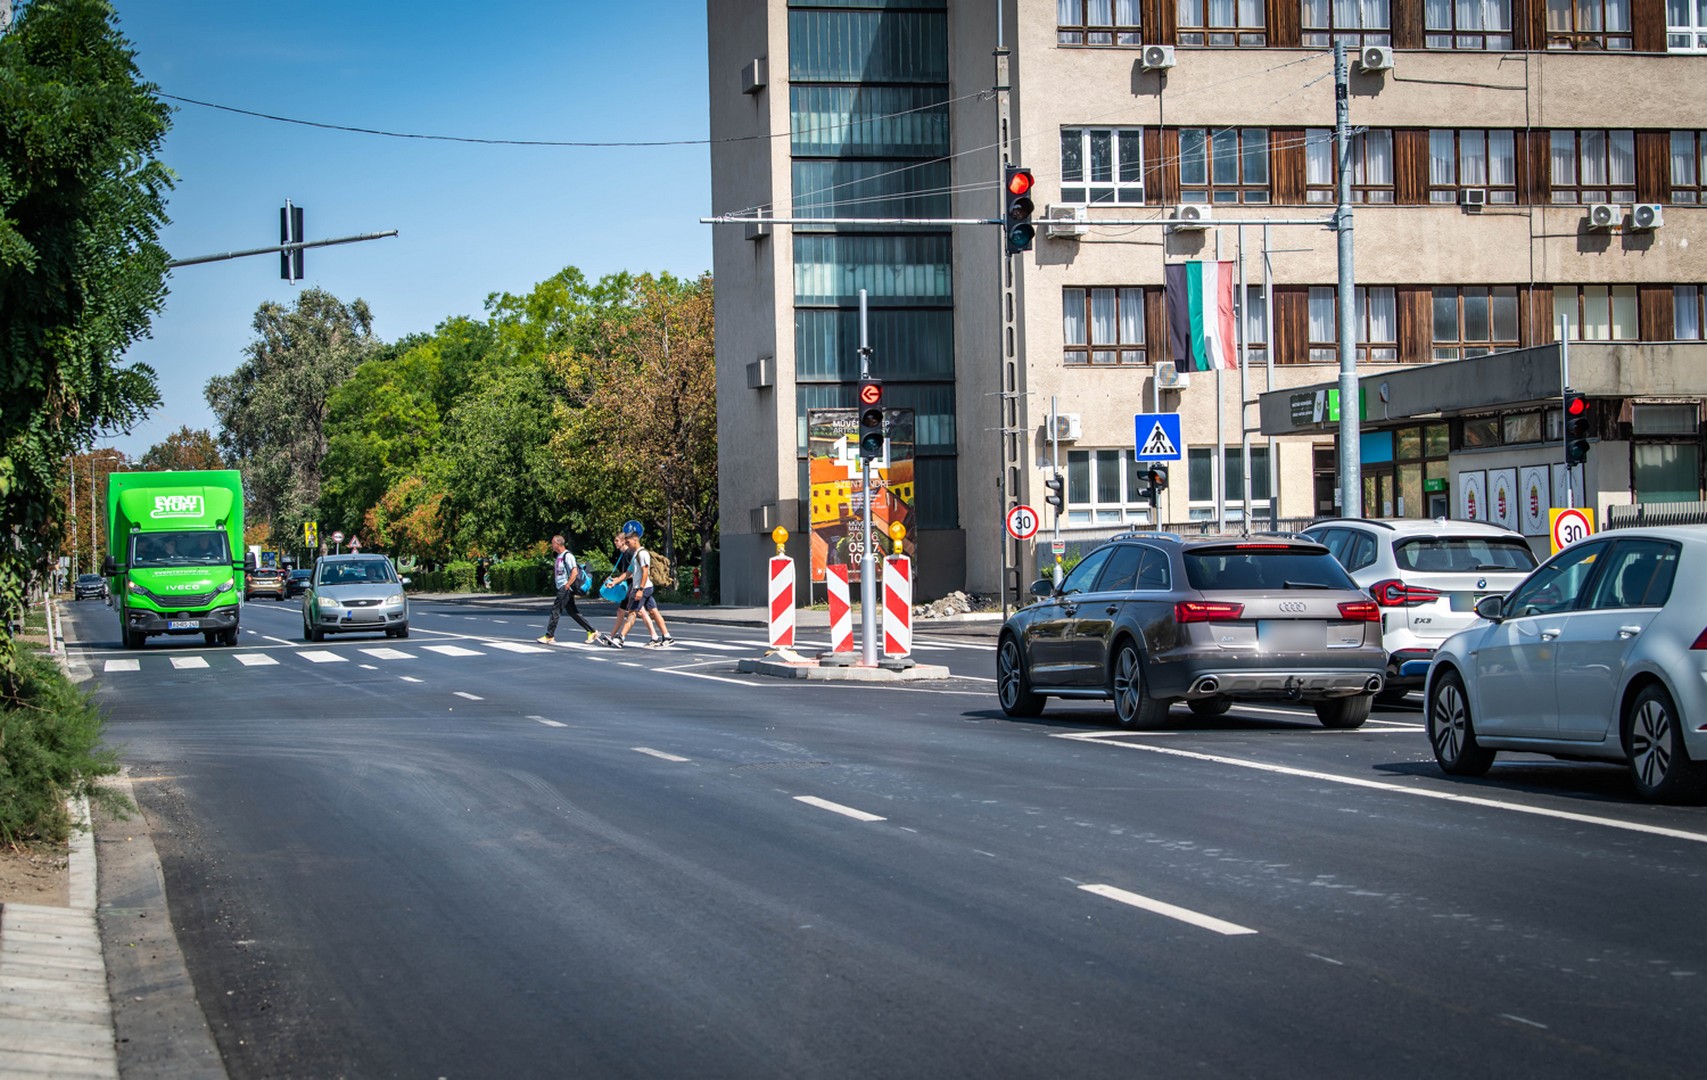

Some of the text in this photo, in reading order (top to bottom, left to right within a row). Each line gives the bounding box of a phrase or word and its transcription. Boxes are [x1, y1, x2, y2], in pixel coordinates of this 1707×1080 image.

[833, 419, 890, 427] MŰVÉEP
[834, 480, 891, 488] SZENTNDRE
[1015, 516, 1031, 530] 30
[848, 532, 880, 542] 206.
[1564, 525, 1582, 543] 30
